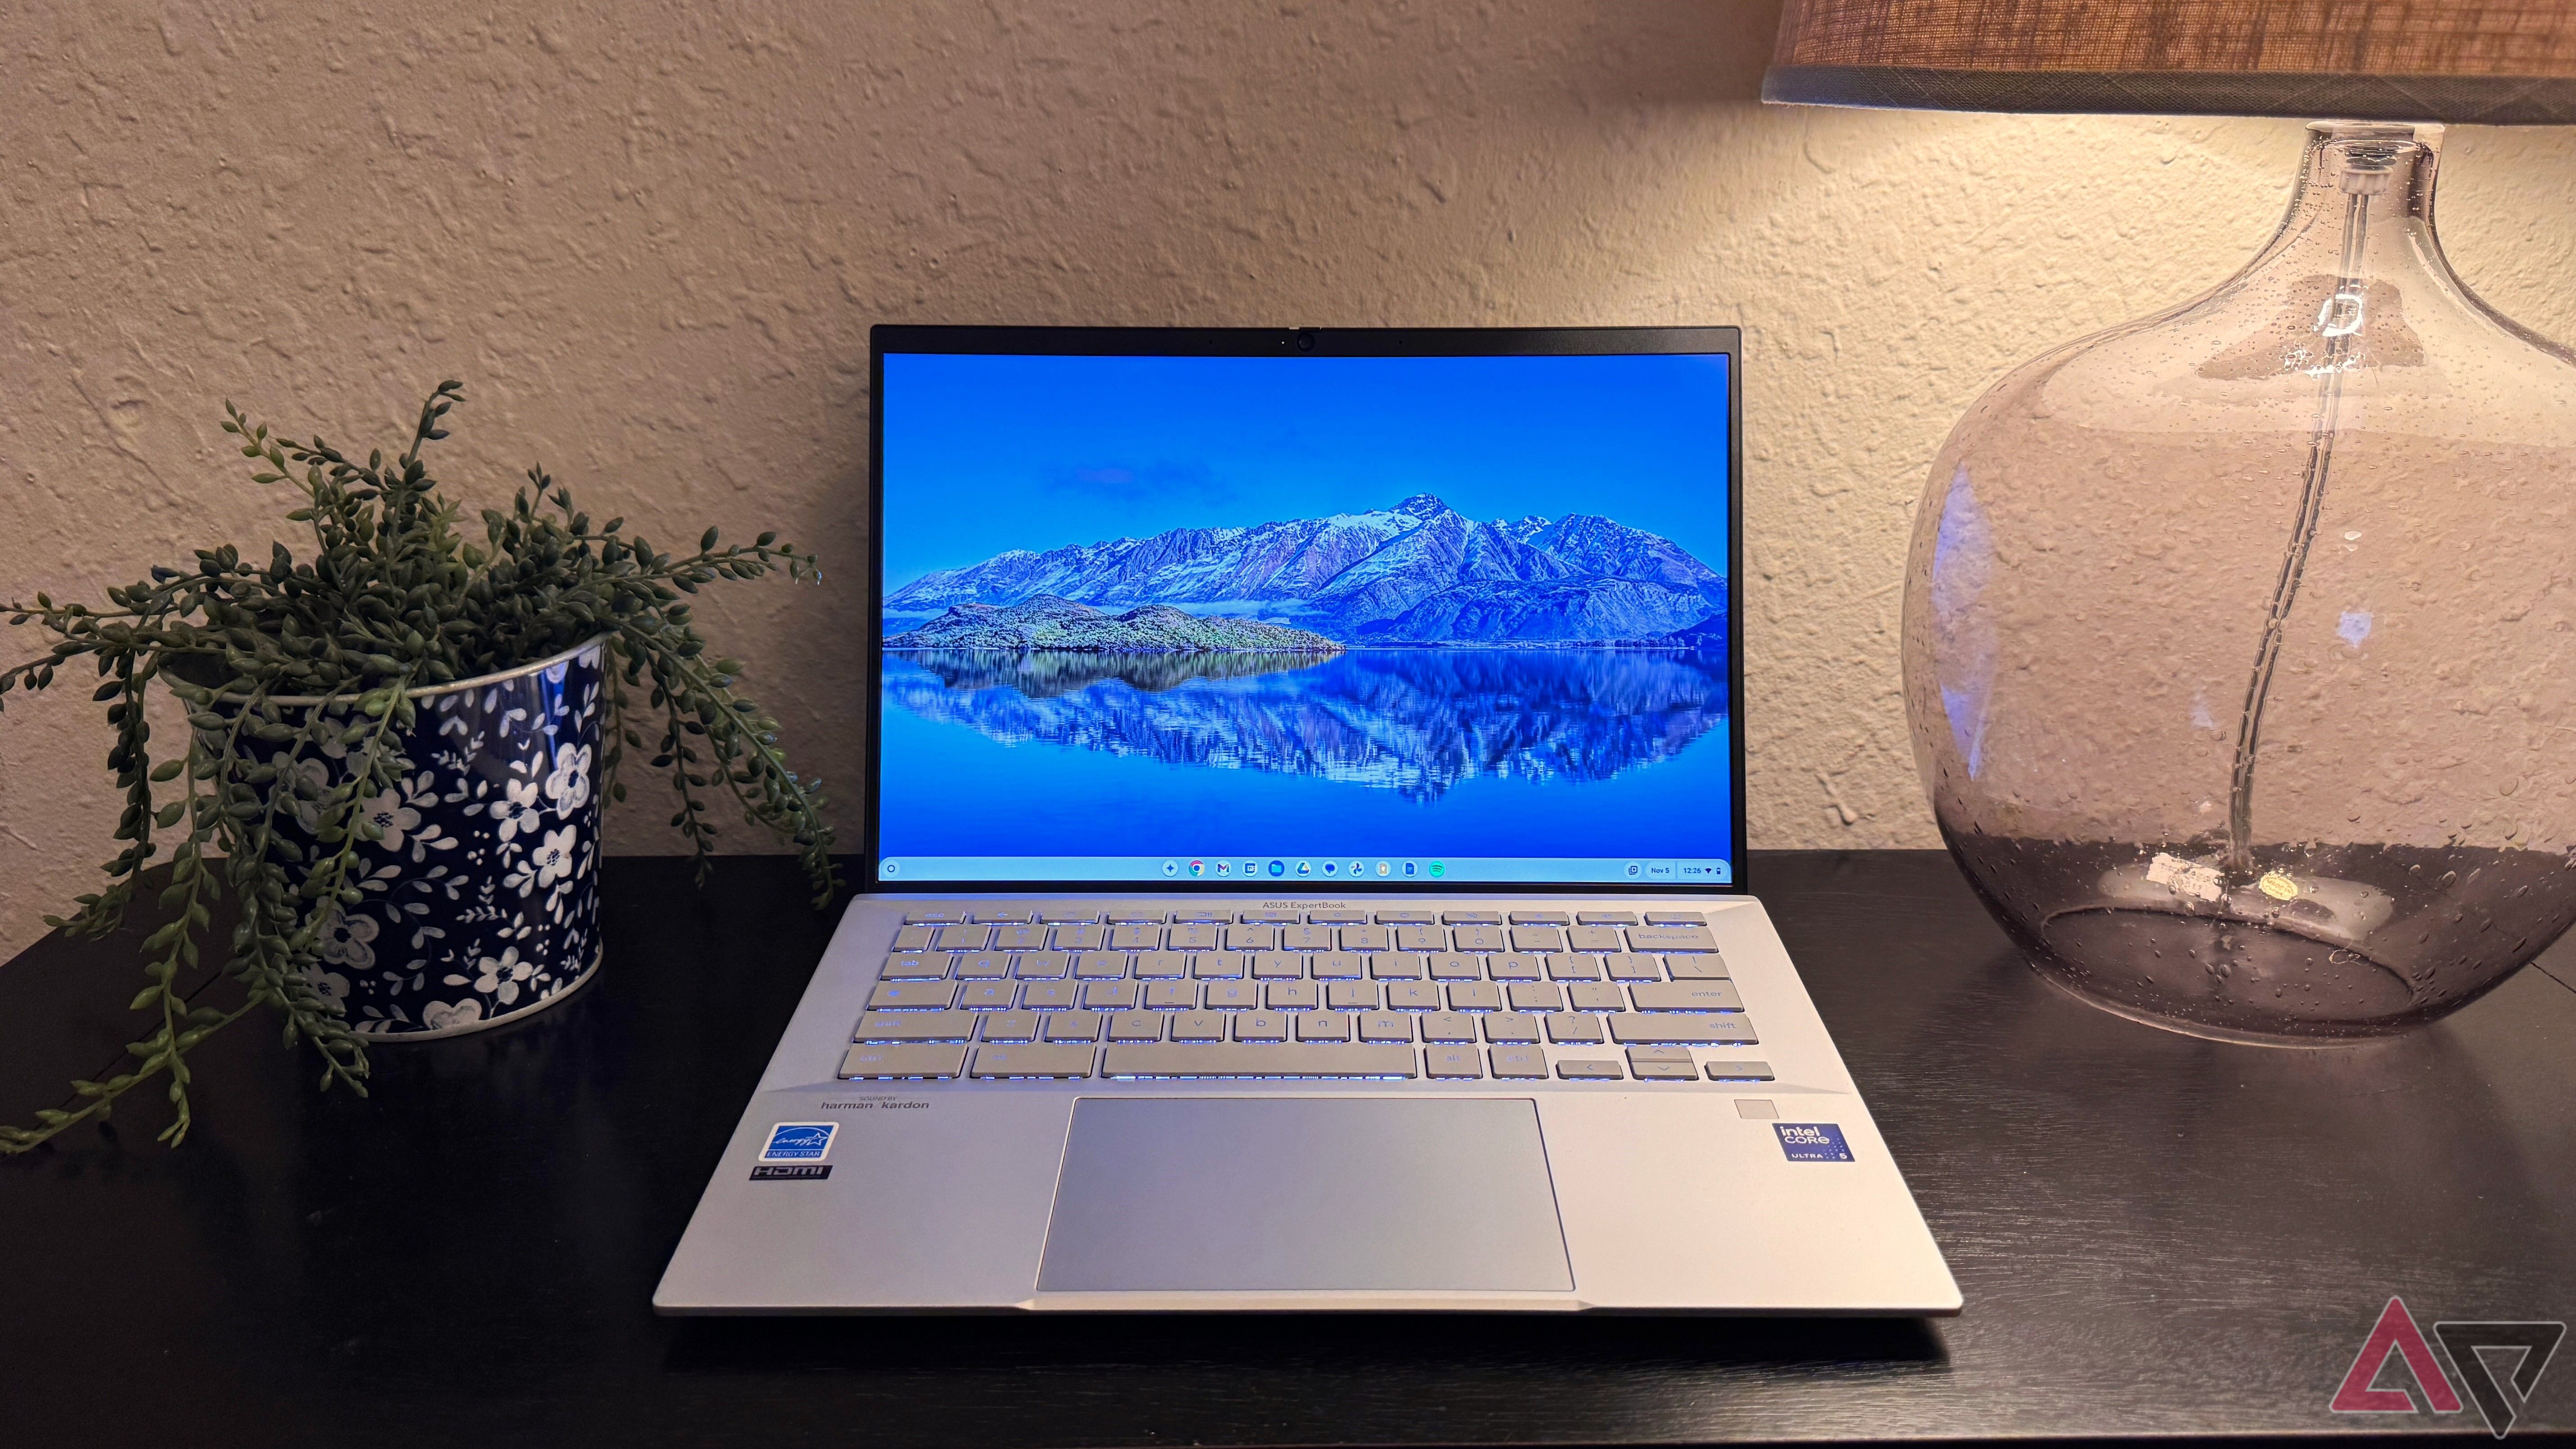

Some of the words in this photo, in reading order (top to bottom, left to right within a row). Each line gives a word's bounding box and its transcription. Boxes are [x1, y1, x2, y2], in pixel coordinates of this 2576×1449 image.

[1274, 960, 1282, 968] y
[1227, 989, 1237, 998] g
[1288, 987, 1297, 995] h
[1409, 988, 1418, 996] k
[1256, 1018, 1266, 1026] b
[1780, 1126, 1820, 1136] intel
[754, 1167, 824, 1176] HDMI
